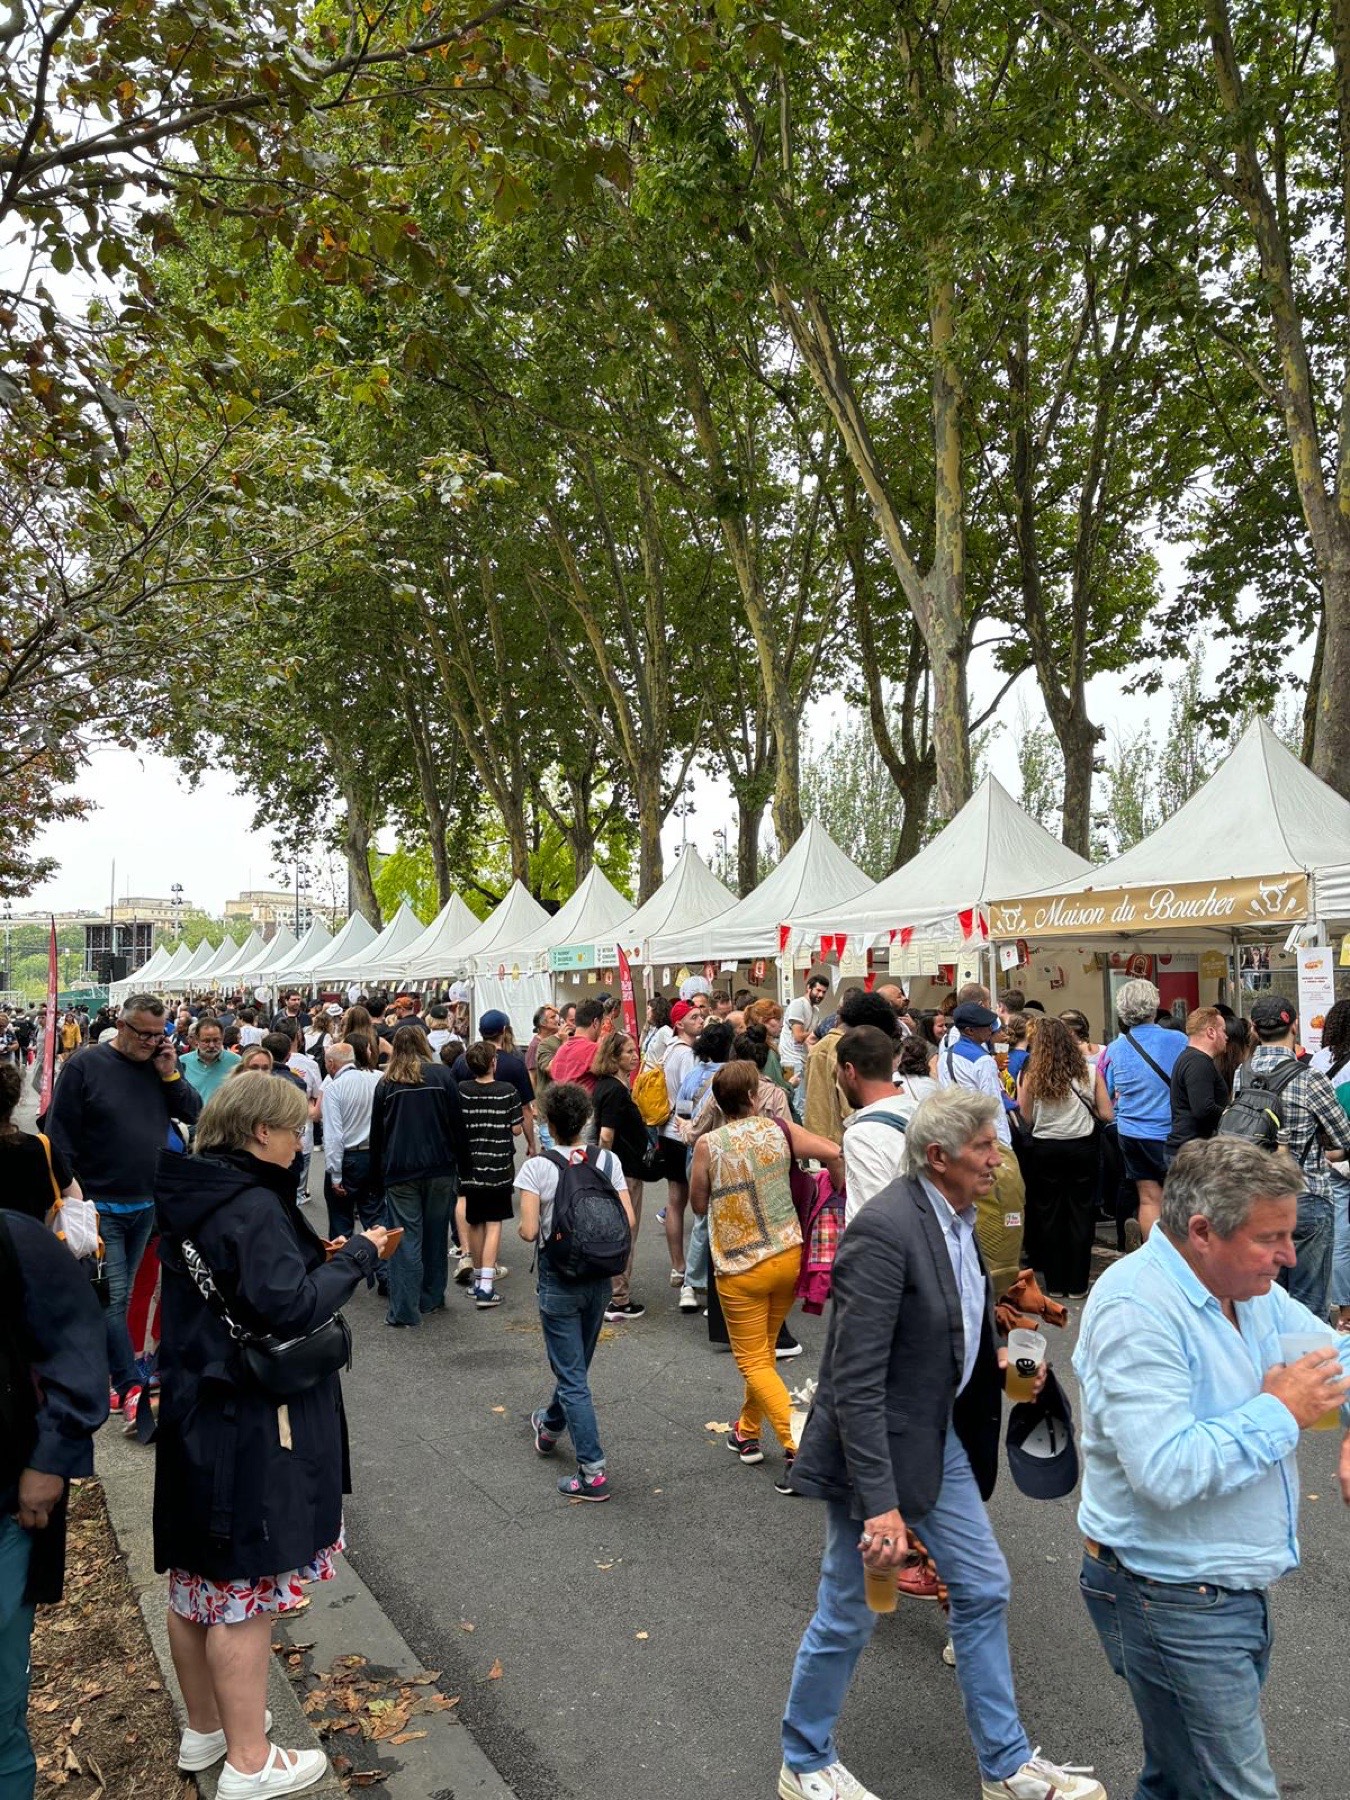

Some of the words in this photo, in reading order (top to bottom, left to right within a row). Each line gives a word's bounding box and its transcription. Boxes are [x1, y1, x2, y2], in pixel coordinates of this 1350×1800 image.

[1034, 897, 1105, 929] Maison
[1111, 893, 1136, 923] du
[1143, 886, 1236, 921] Boucher
